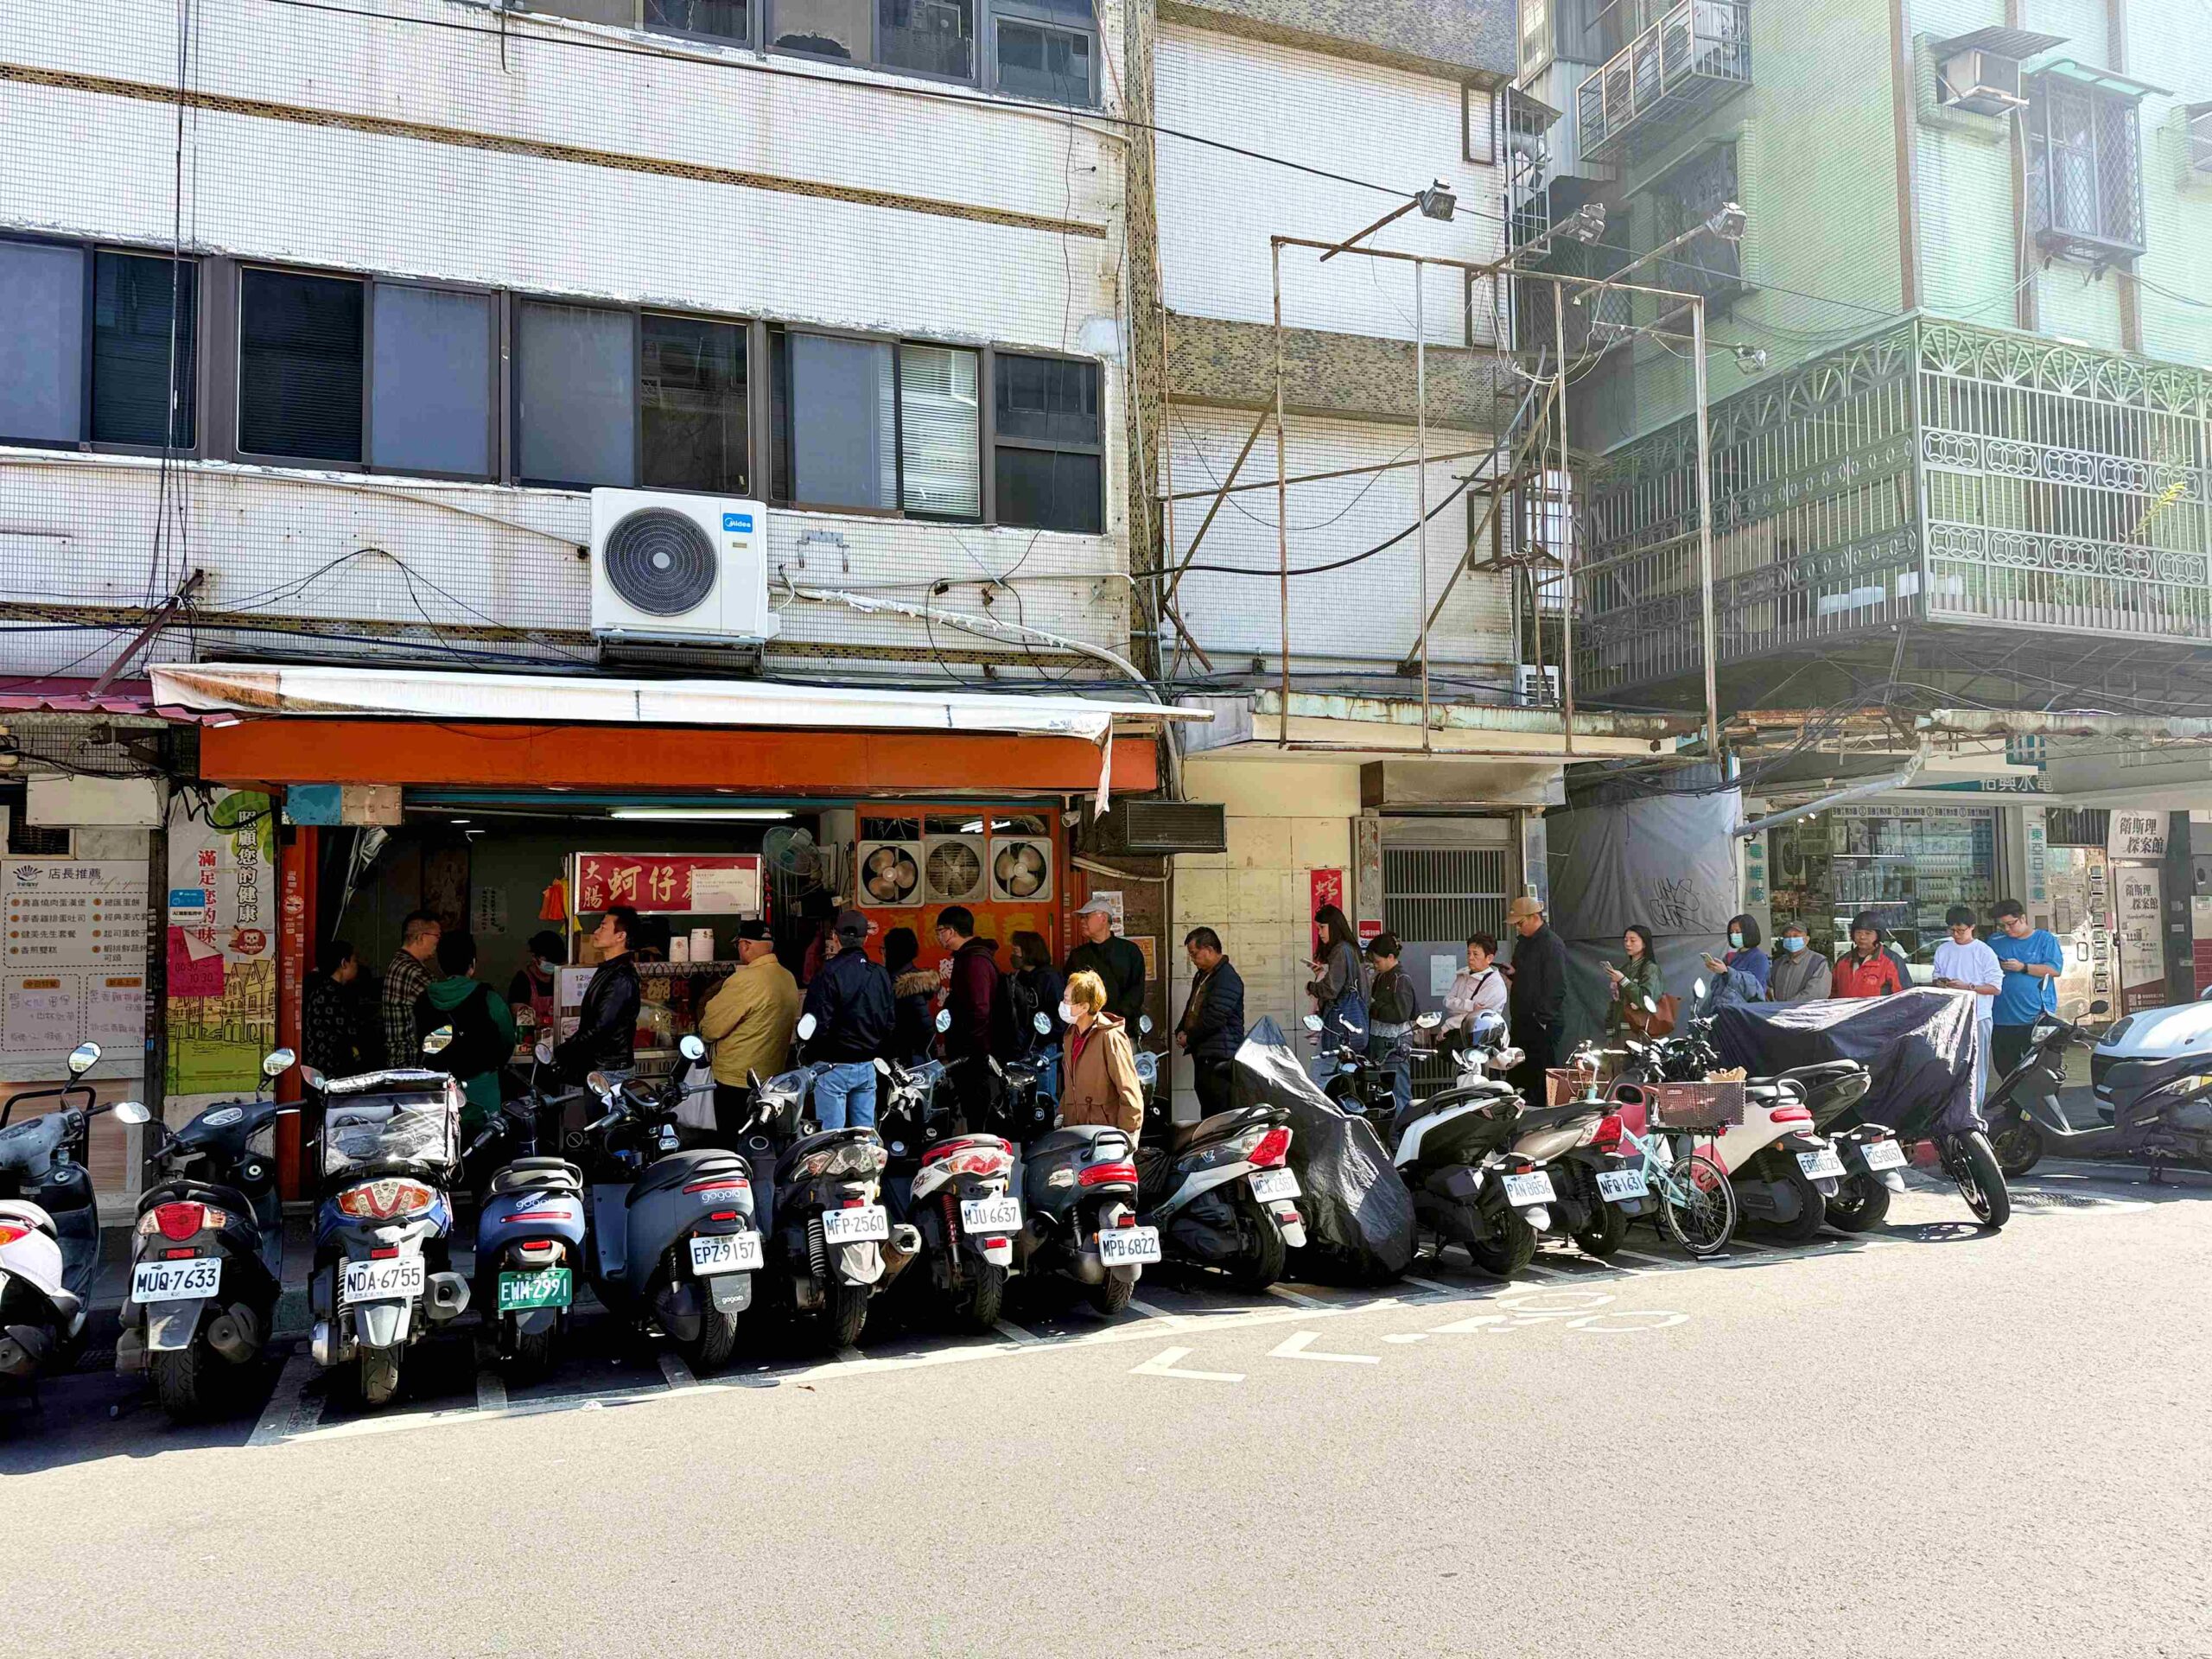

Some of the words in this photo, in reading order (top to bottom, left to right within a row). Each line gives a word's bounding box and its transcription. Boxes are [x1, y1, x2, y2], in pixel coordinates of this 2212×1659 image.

[728, 519, 751, 528] Midea
[2120, 817, 2157, 836] 衛斯理
[2126, 836, 2164, 855] 探案館
[48, 868, 101, 880] 店長推薦
[237, 810, 258, 924] 照顧您的健康
[582, 860, 603, 908] 大腸
[198, 849, 217, 949] 滿足您的味
[721, 1294, 744, 1305] gogoro
